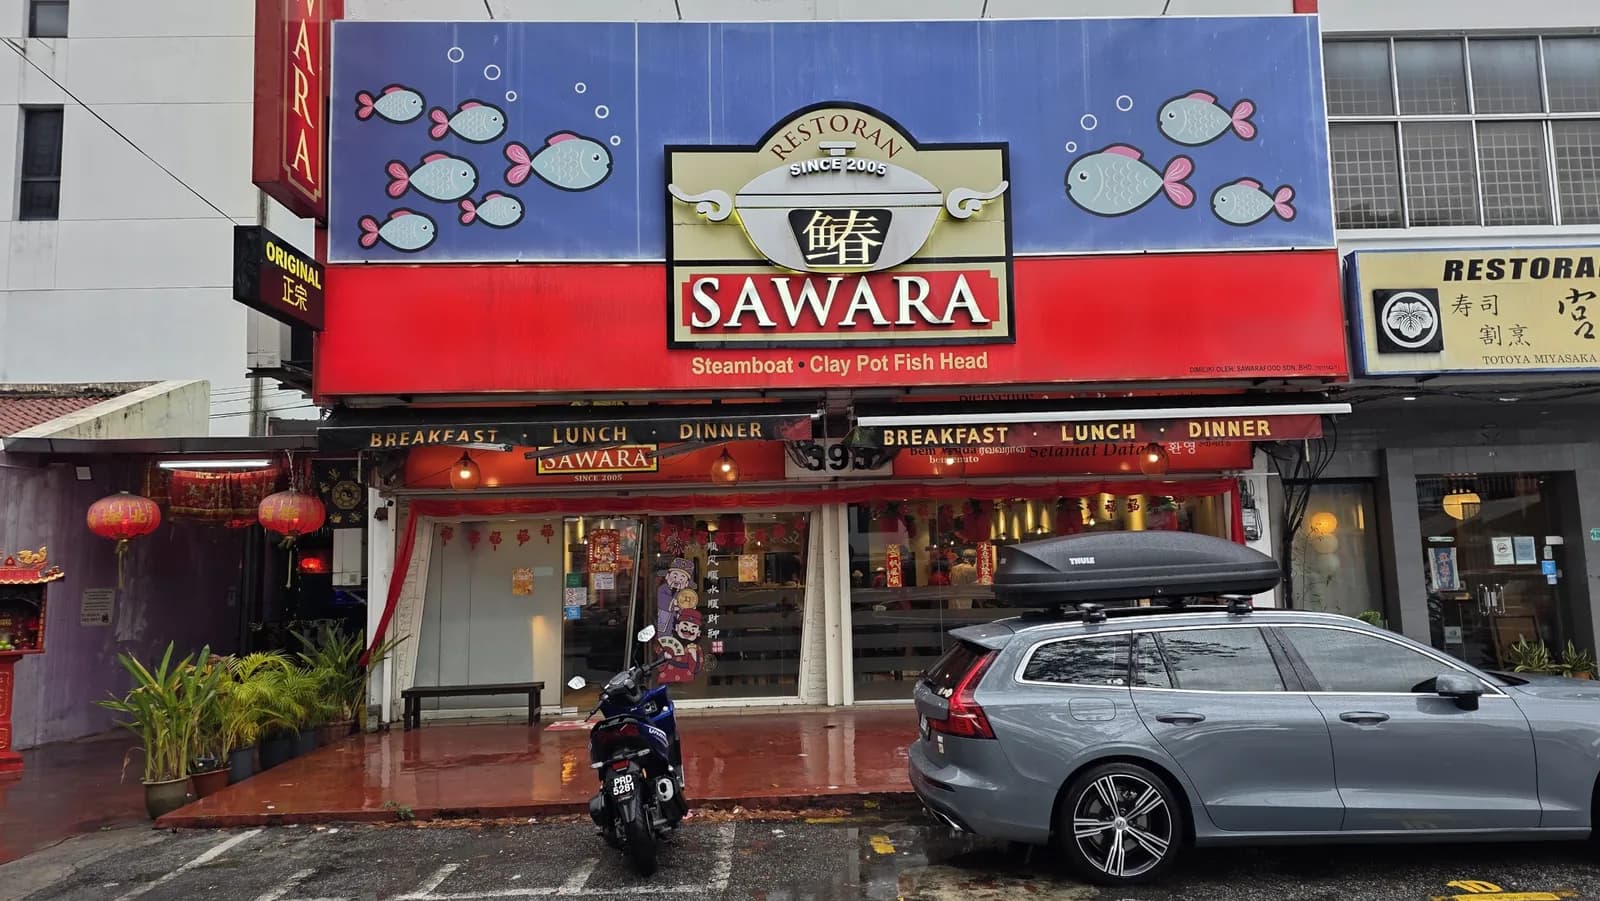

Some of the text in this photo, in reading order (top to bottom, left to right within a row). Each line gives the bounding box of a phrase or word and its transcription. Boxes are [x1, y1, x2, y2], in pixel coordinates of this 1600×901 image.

[770, 114, 903, 161] RESTORAN
[790, 158, 888, 178] SINCE 2005
[265, 240, 321, 290] ORIGINAL
[1443, 256, 1600, 282] RESTORA
[282, 275, 308, 311] 正宗
[691, 273, 991, 329] SAWARA
[1451, 293, 1499, 318] 寿司
[1479, 324, 1531, 347] 割烹
[691, 351, 989, 376] Steamboat Clay Pot Fish Head
[1482, 353, 1597, 366] TOTOYA MIYASAKA
[370, 422, 763, 448] BREAKFAST LUNCH DINNER
[883, 419, 1272, 446] BREAKFAST LUNCH DINNER
[1029, 443, 1098, 458] Selamat
[1168, 441, 1197, 455] 환영
[574, 473, 623, 482] SINCE 2005
[1069, 557, 1096, 566] THULE
[613, 782, 635, 796] 5281
[614, 774, 633, 787] PRD
